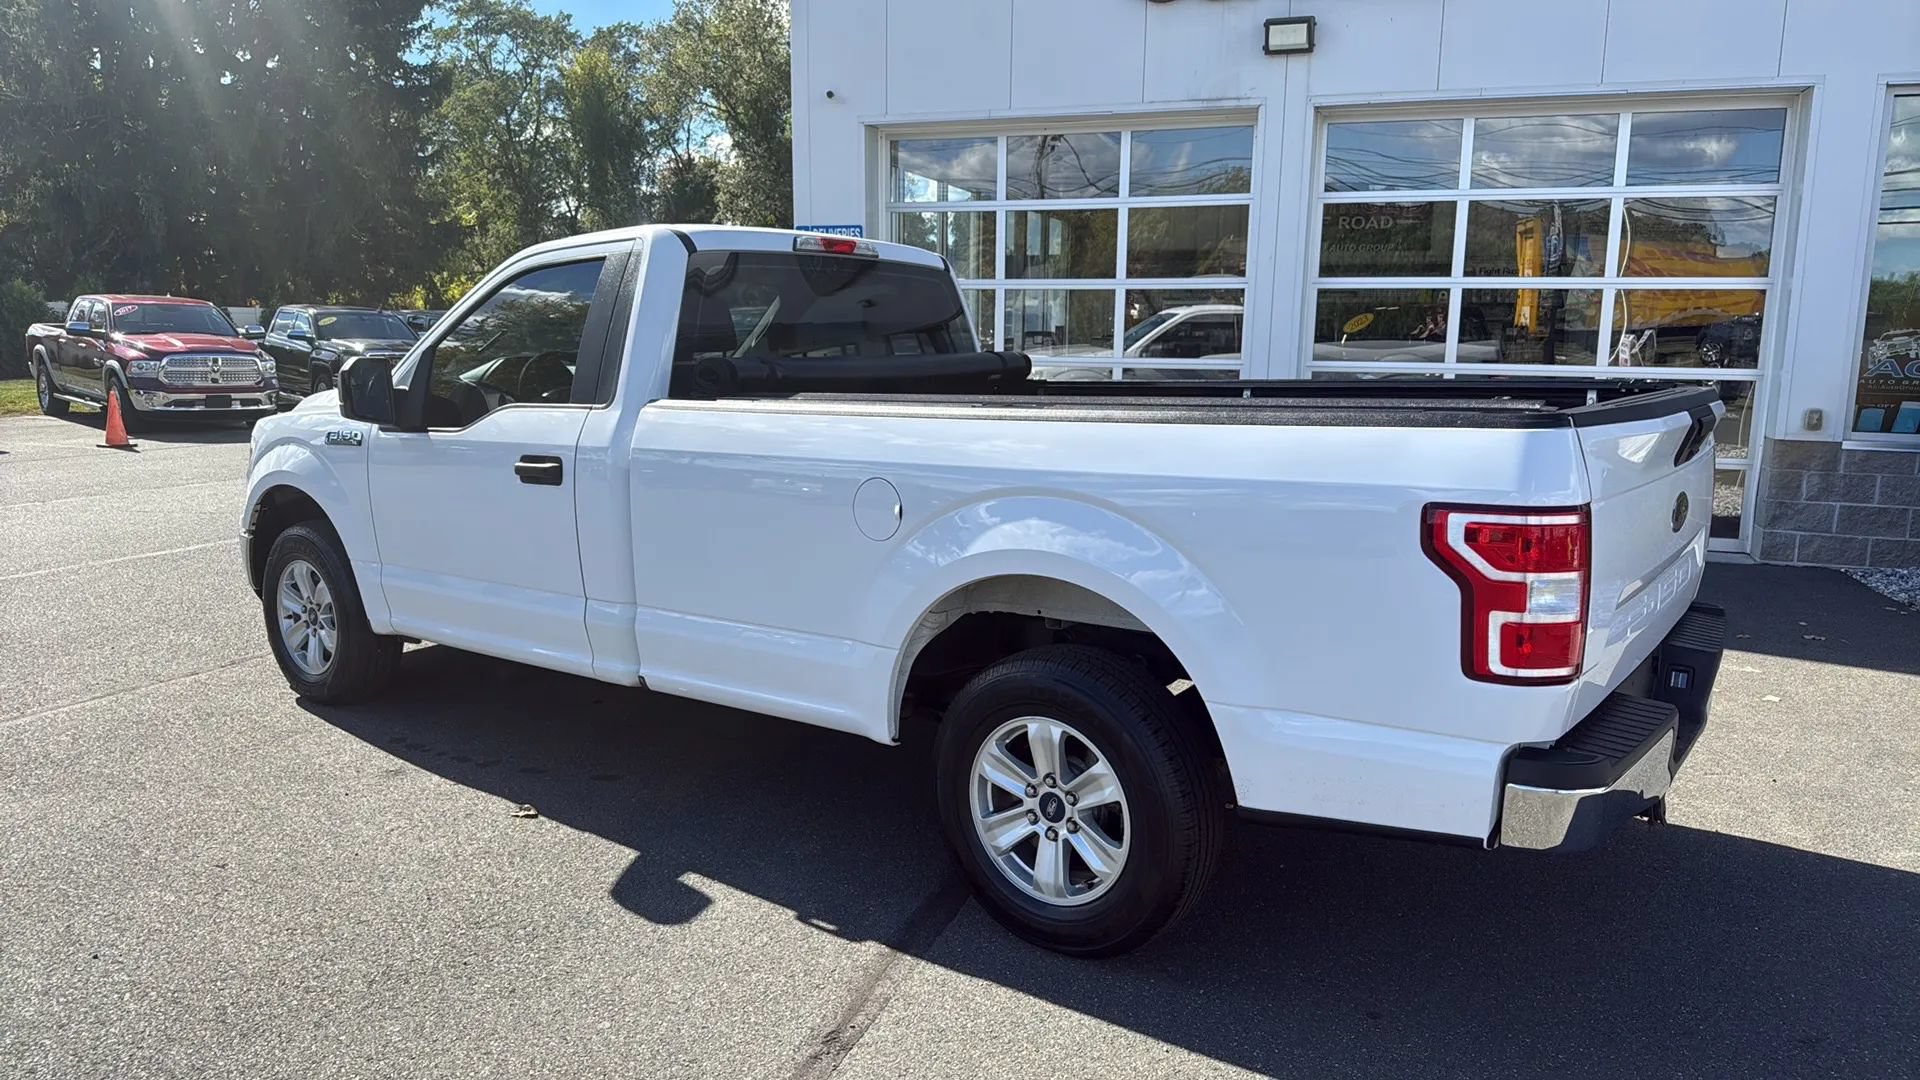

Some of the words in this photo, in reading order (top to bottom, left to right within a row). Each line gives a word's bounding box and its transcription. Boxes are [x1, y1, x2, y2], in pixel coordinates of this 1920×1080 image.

[1338, 215, 1394, 230] ROAD
[1329, 243, 1357, 253] AUTO
[1358, 242, 1394, 252] GROUP
[1349, 314, 1369, 331] 2023
